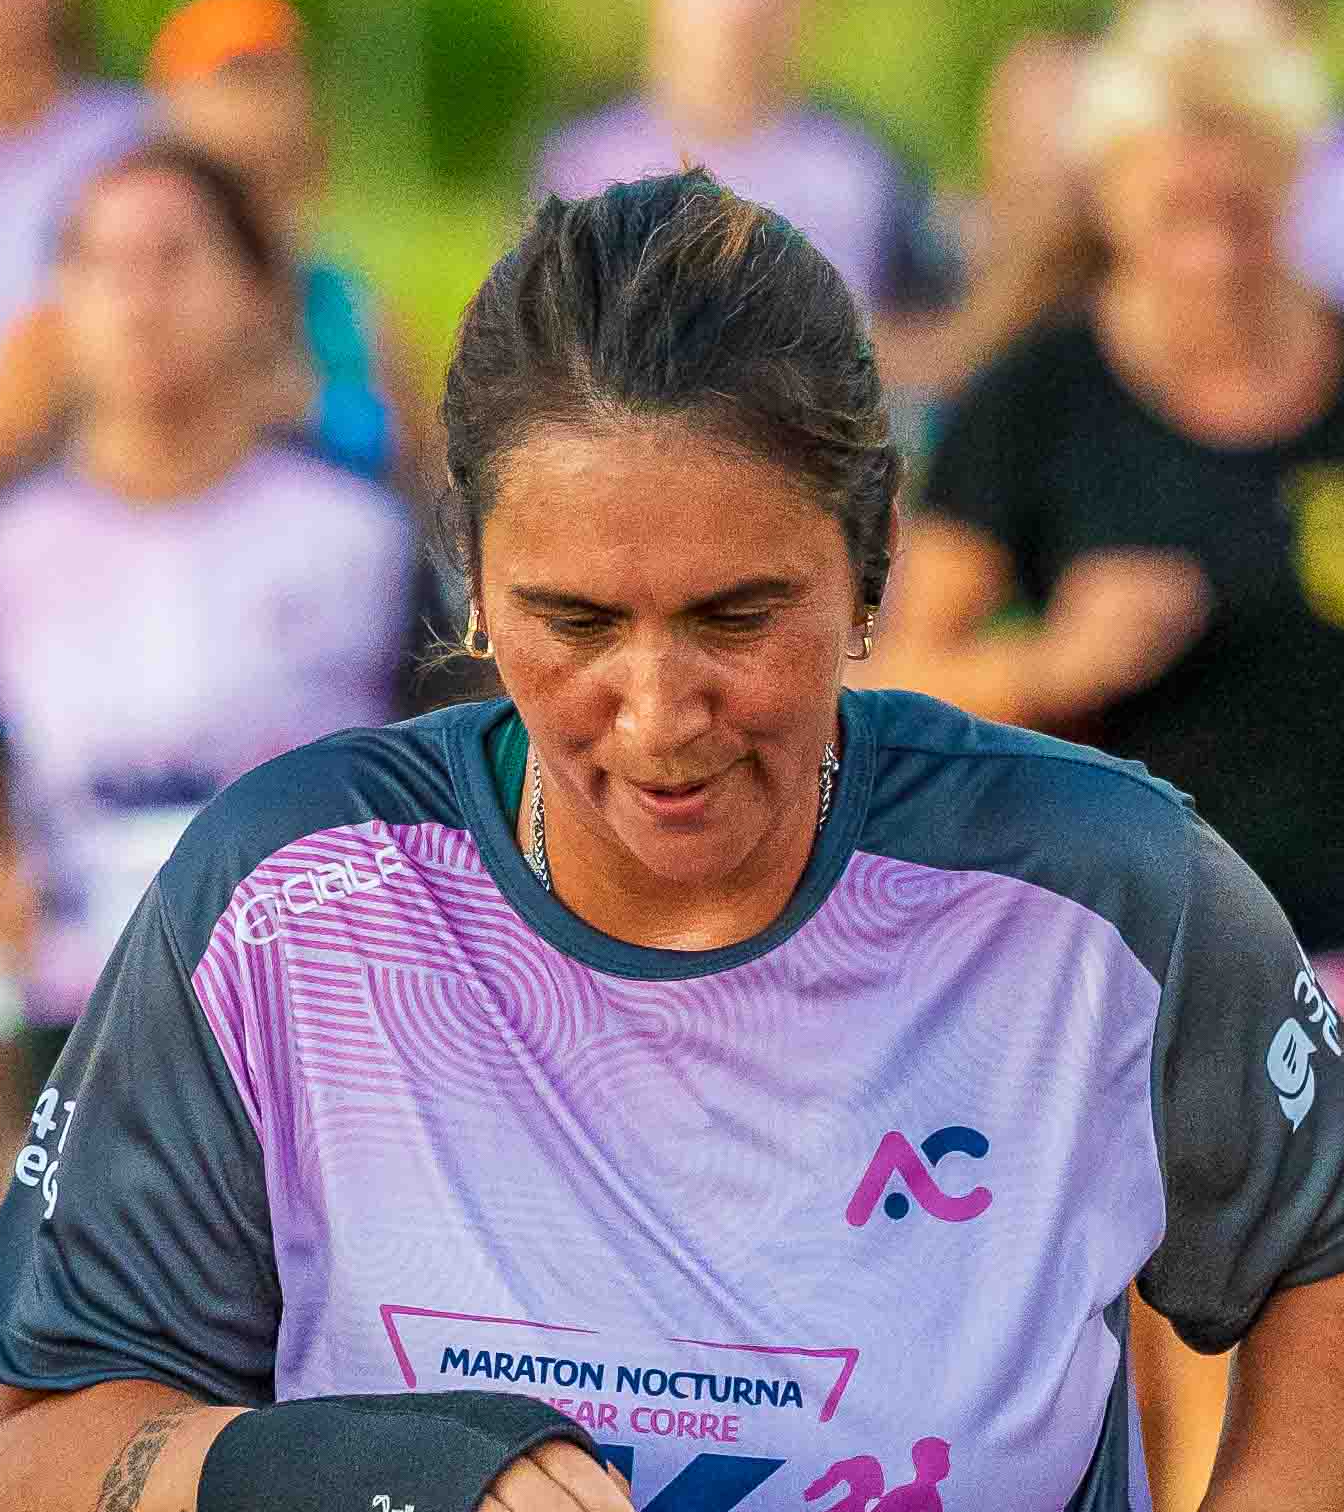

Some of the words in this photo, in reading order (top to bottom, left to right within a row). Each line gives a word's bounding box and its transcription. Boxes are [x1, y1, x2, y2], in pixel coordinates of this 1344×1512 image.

[439, 1347, 604, 1392] MARATON
[616, 1365, 803, 1408] NOCTURNA
[549, 1398, 619, 1433] EAR
[630, 1407, 740, 1443] CORRE
